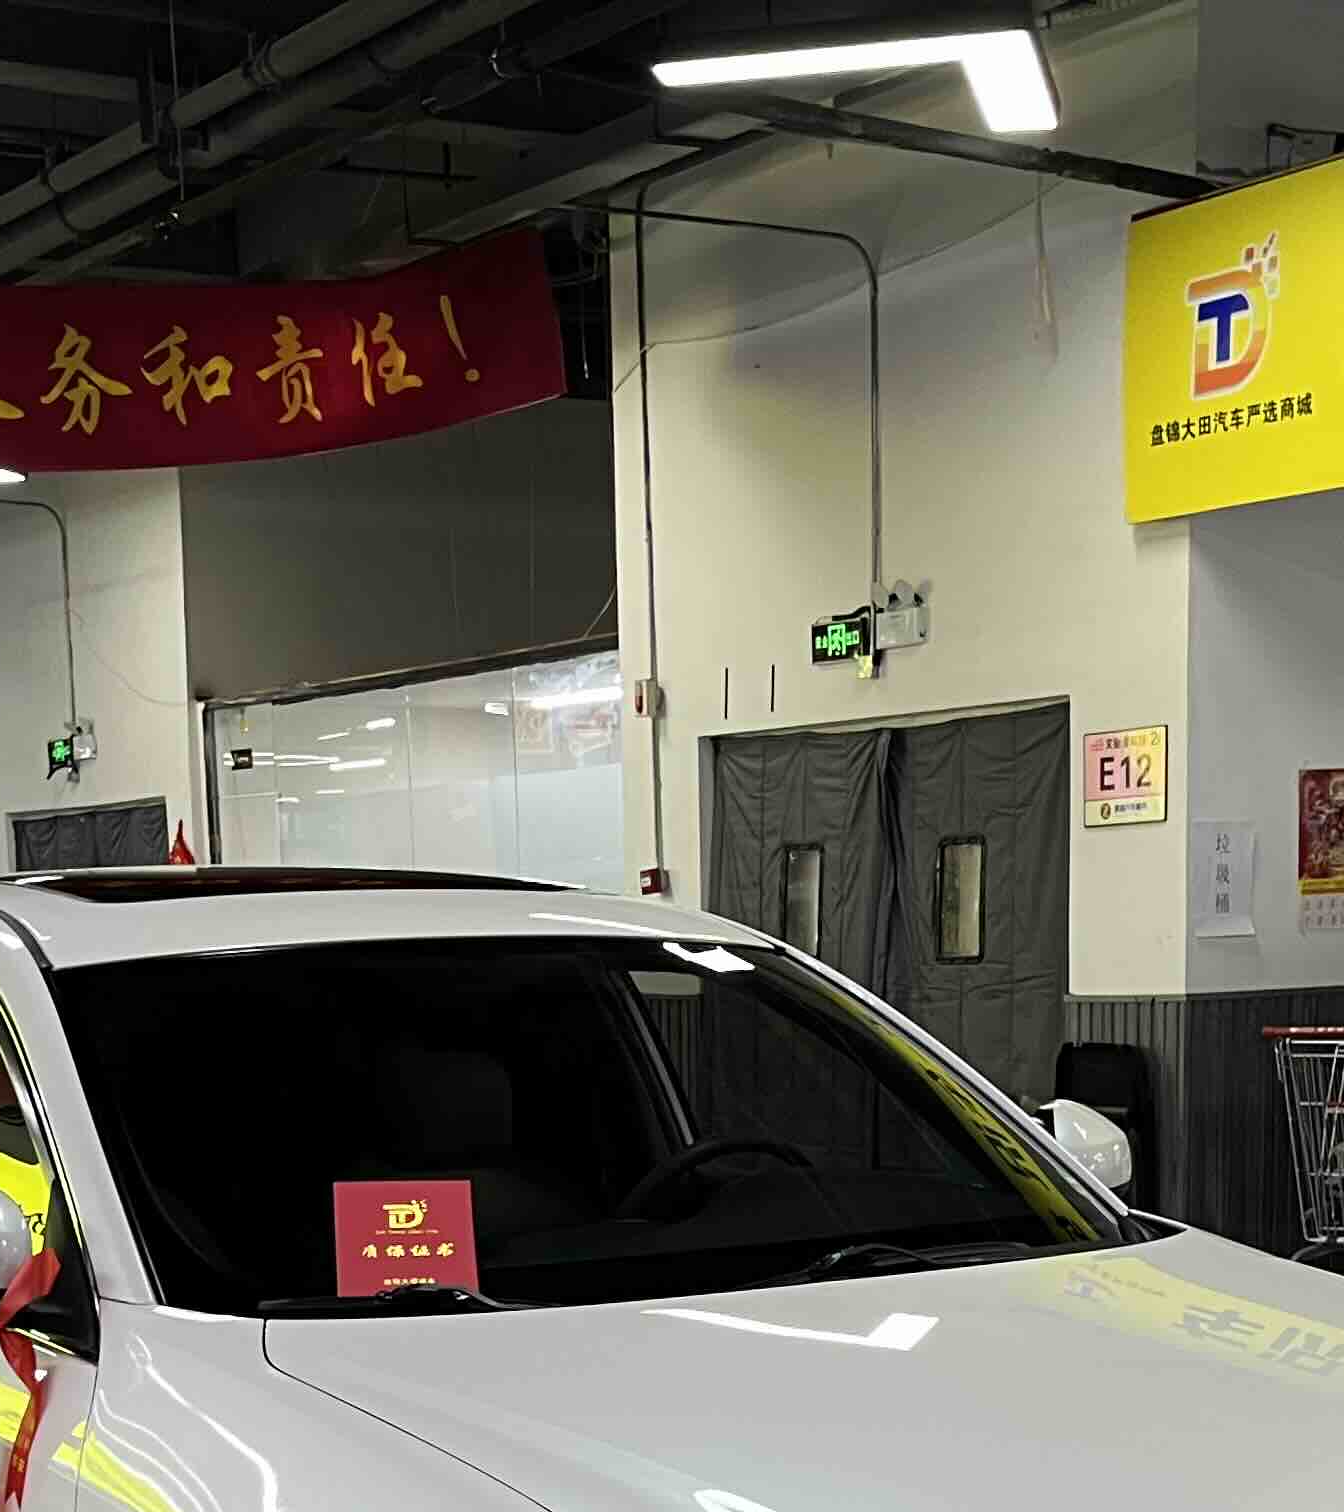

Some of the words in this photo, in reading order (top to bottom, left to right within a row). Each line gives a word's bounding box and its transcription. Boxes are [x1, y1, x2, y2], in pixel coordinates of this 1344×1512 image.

[1150, 391, 1314, 447] 盘锦大田汽车严选商城
[1099, 754, 1153, 792] E12
[1215, 831, 1233, 914] 垃圾桶
